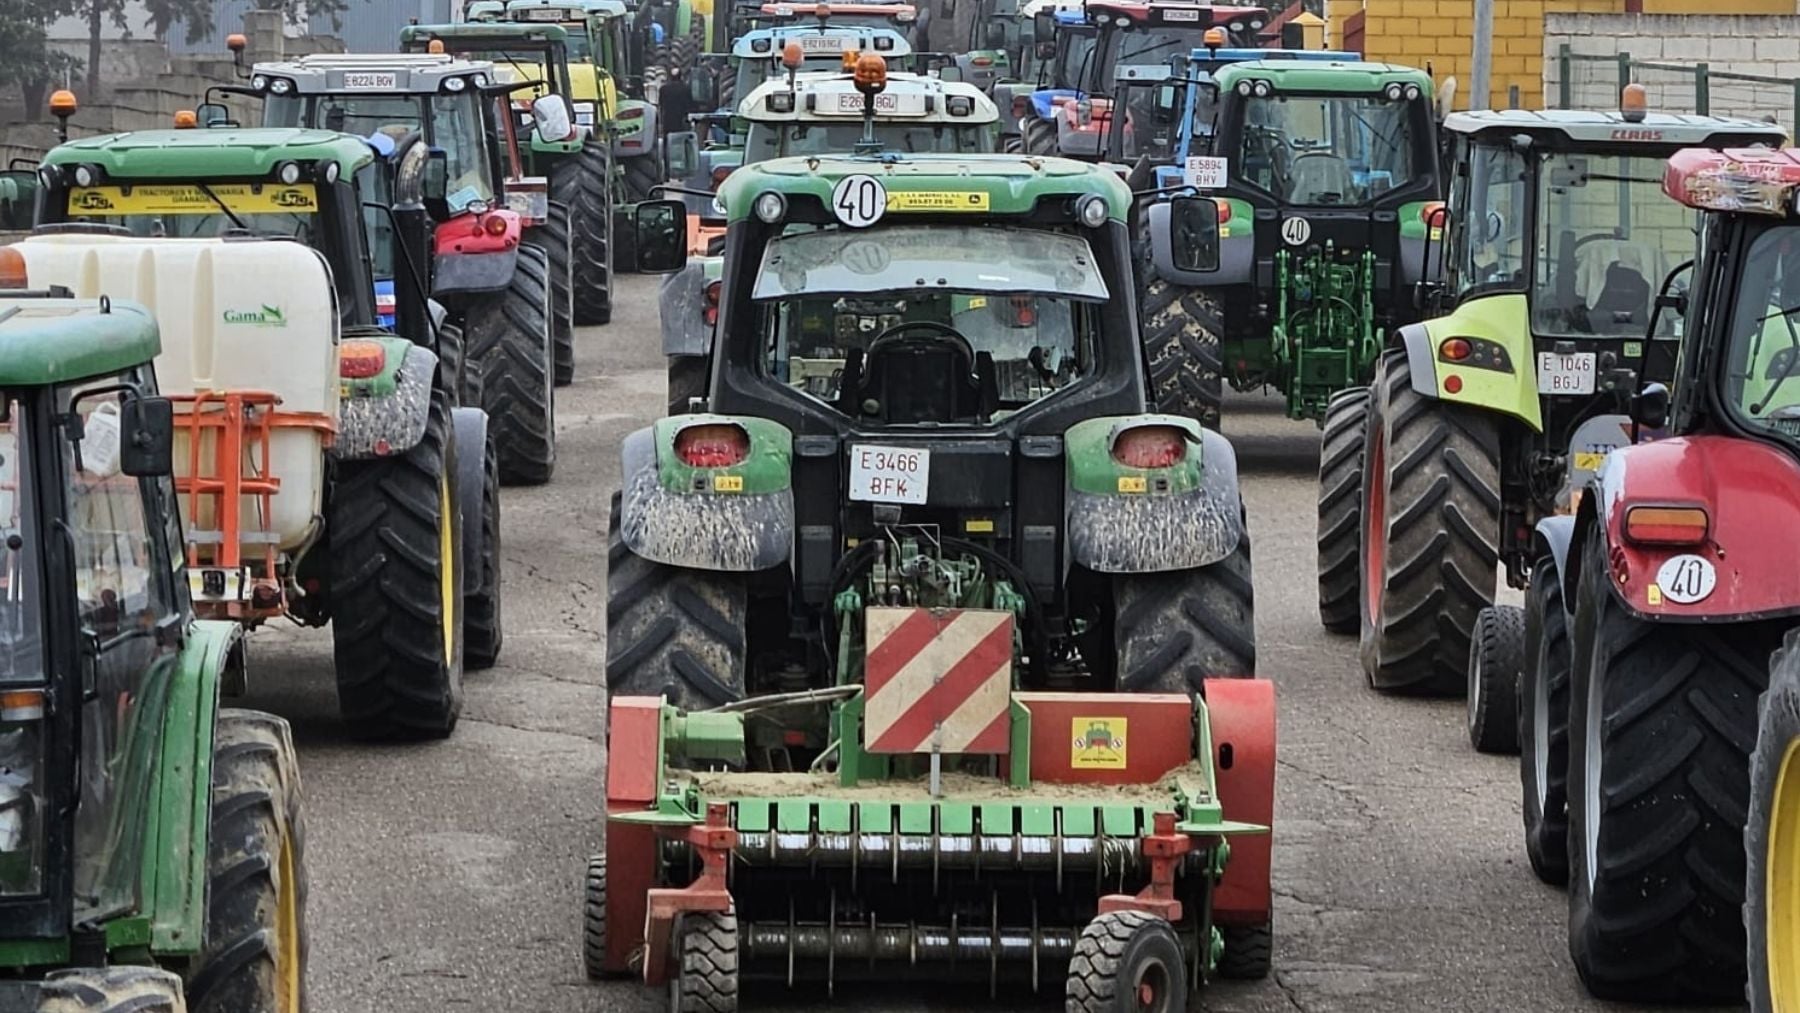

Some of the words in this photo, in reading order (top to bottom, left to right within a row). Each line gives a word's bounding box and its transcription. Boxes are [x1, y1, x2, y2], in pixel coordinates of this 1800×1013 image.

[875, 95, 895, 109] BGL
[1610, 129, 1663, 140] CLAAS
[1196, 174, 1217, 185] BHV
[838, 179, 877, 221] 40
[1286, 219, 1304, 241] 40
[223, 309, 265, 322] Gama
[1560, 357, 1590, 371] 1046
[1553, 375, 1580, 390] BGJ
[870, 476, 907, 497] BFK
[1671, 559, 1703, 597] 40
